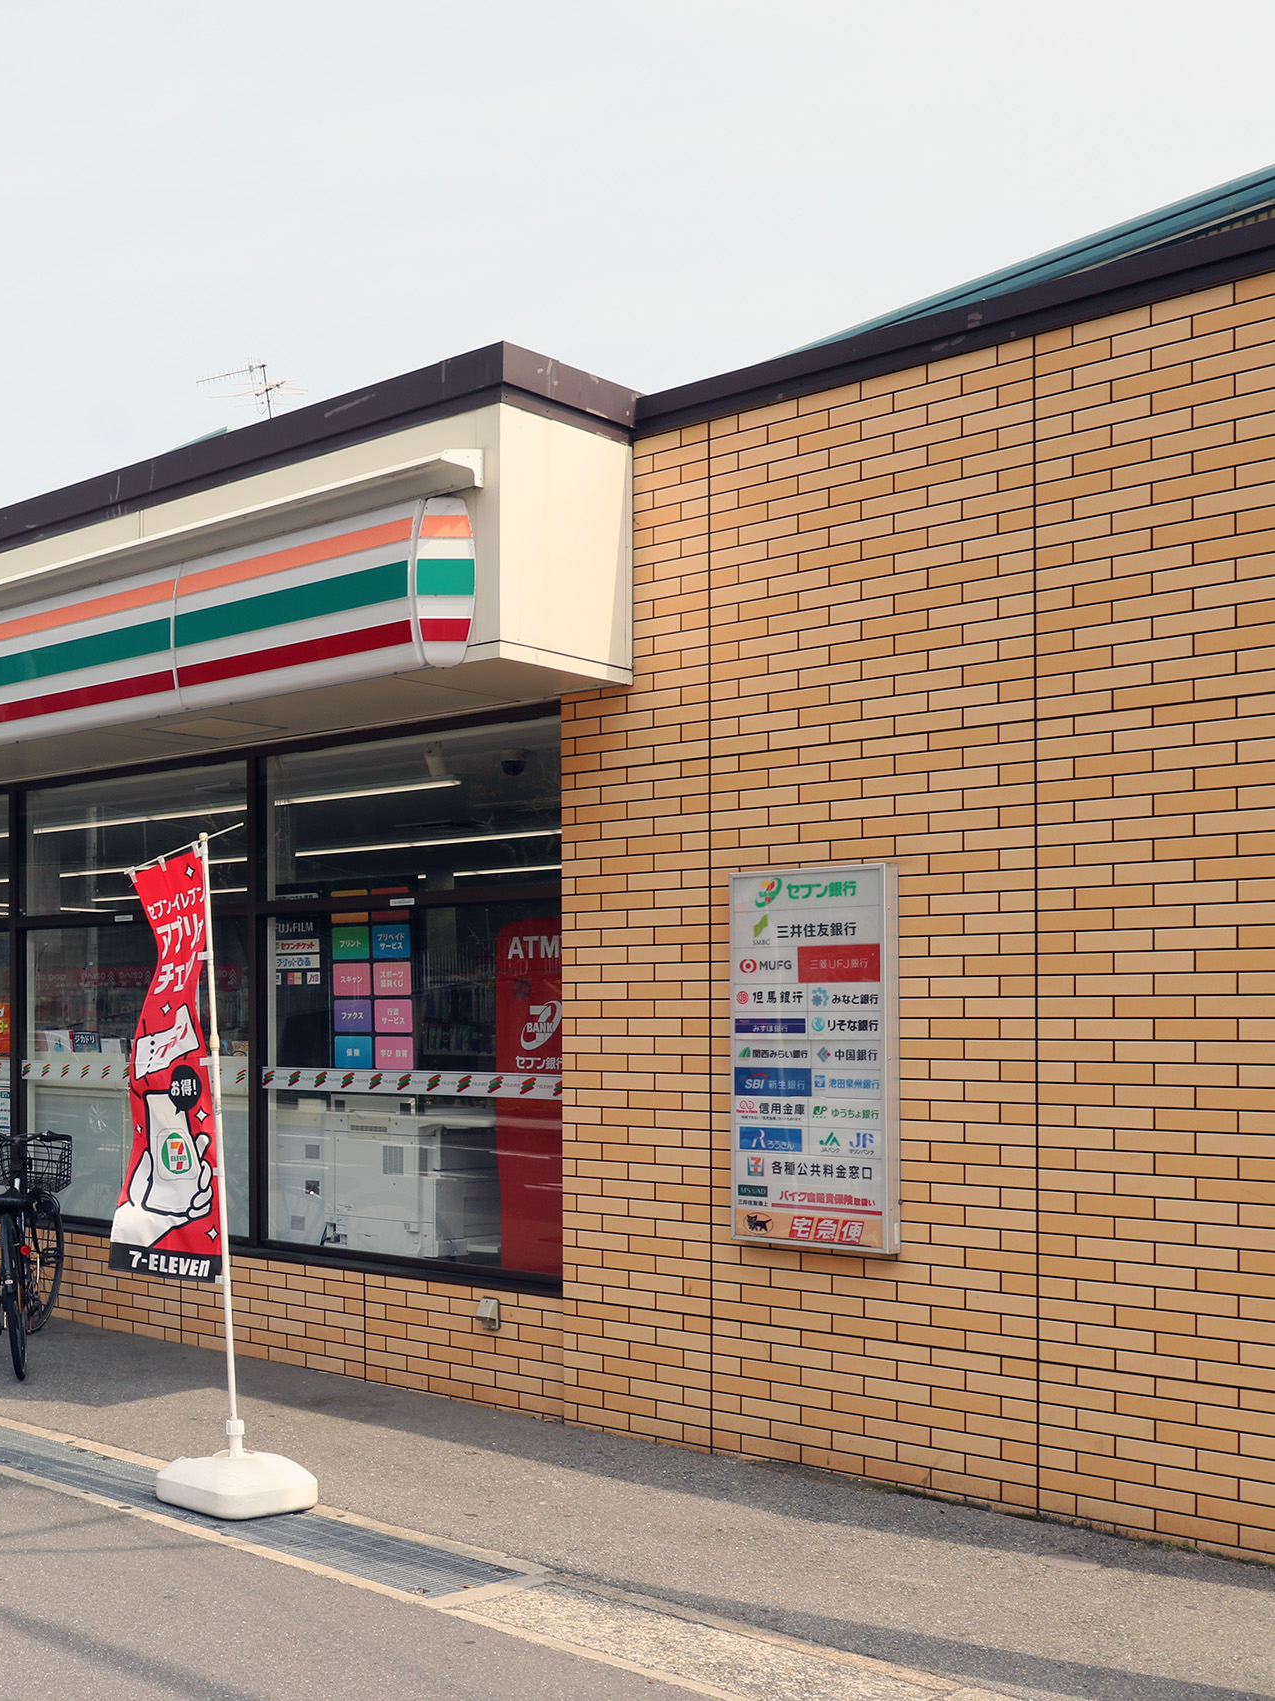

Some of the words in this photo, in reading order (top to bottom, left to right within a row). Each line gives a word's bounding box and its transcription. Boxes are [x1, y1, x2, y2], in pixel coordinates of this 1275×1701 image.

[787, 881, 856, 899] セブン銀行
[777, 922, 856, 938] 三井住友銀行
[377, 932, 405, 941] プリペイド
[280, 941, 315, 950] セブンチケット
[340, 939, 361, 948] プリント
[380, 941, 403, 950] サービス
[507, 935, 560, 959] ATM
[759, 960, 792, 971] MUFG
[810, 958, 868, 969] 三菱UFJ銀行
[340, 975, 363, 983] スキャン
[380, 971, 403, 979] スポーツ
[753, 991, 803, 1004] 但馬銀行
[832, 994, 878, 1005] みなと銀行
[341, 1012, 364, 1020] ファクス
[381, 1016, 405, 1025] サービス
[526, 1022, 554, 1033] BANK
[752, 1025, 788, 1033] みずほ銀行
[828, 1019, 878, 1031] りそな銀行
[346, 1048, 360, 1057] 保険
[752, 1049, 808, 1059] 関西みらい銀行
[835, 1050, 878, 1061] 中国銀行
[171, 1079, 197, 1096] お得!
[745, 1078, 764, 1089] SBI
[768, 1081, 805, 1090] 新生銀行
[828, 1079, 880, 1089] 池田泉州銀行
[759, 1103, 805, 1115] 信用金庫
[831, 1109, 879, 1120] ゆうちょ銀行
[767, 1141, 794, 1150] ろうきん
[771, 1161, 872, 1180] 各種公共料金窓口
[791, 1217, 864, 1244] 宅急便
